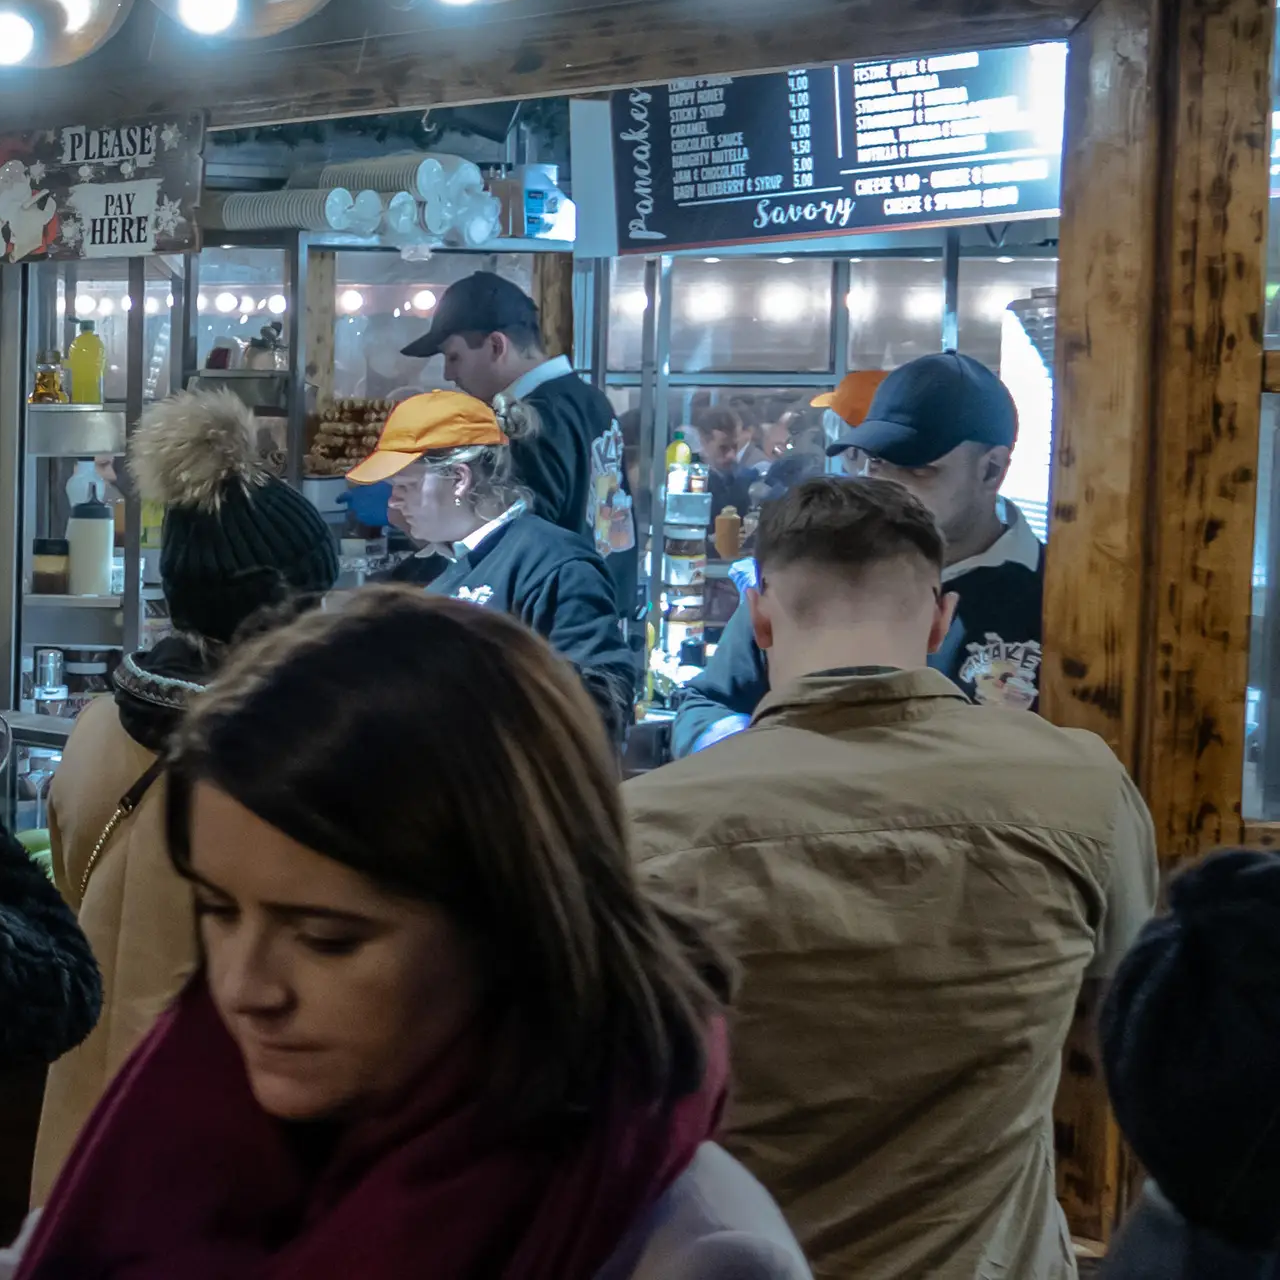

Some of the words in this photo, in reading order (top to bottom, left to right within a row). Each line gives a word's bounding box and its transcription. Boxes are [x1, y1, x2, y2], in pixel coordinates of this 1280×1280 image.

[70, 125, 154, 162] PLEASE
[755, 175, 783, 191] SYRUP
[104, 192, 136, 216] PAY
[753, 196, 856, 229] Savory
[90, 216, 149, 245] HERE
